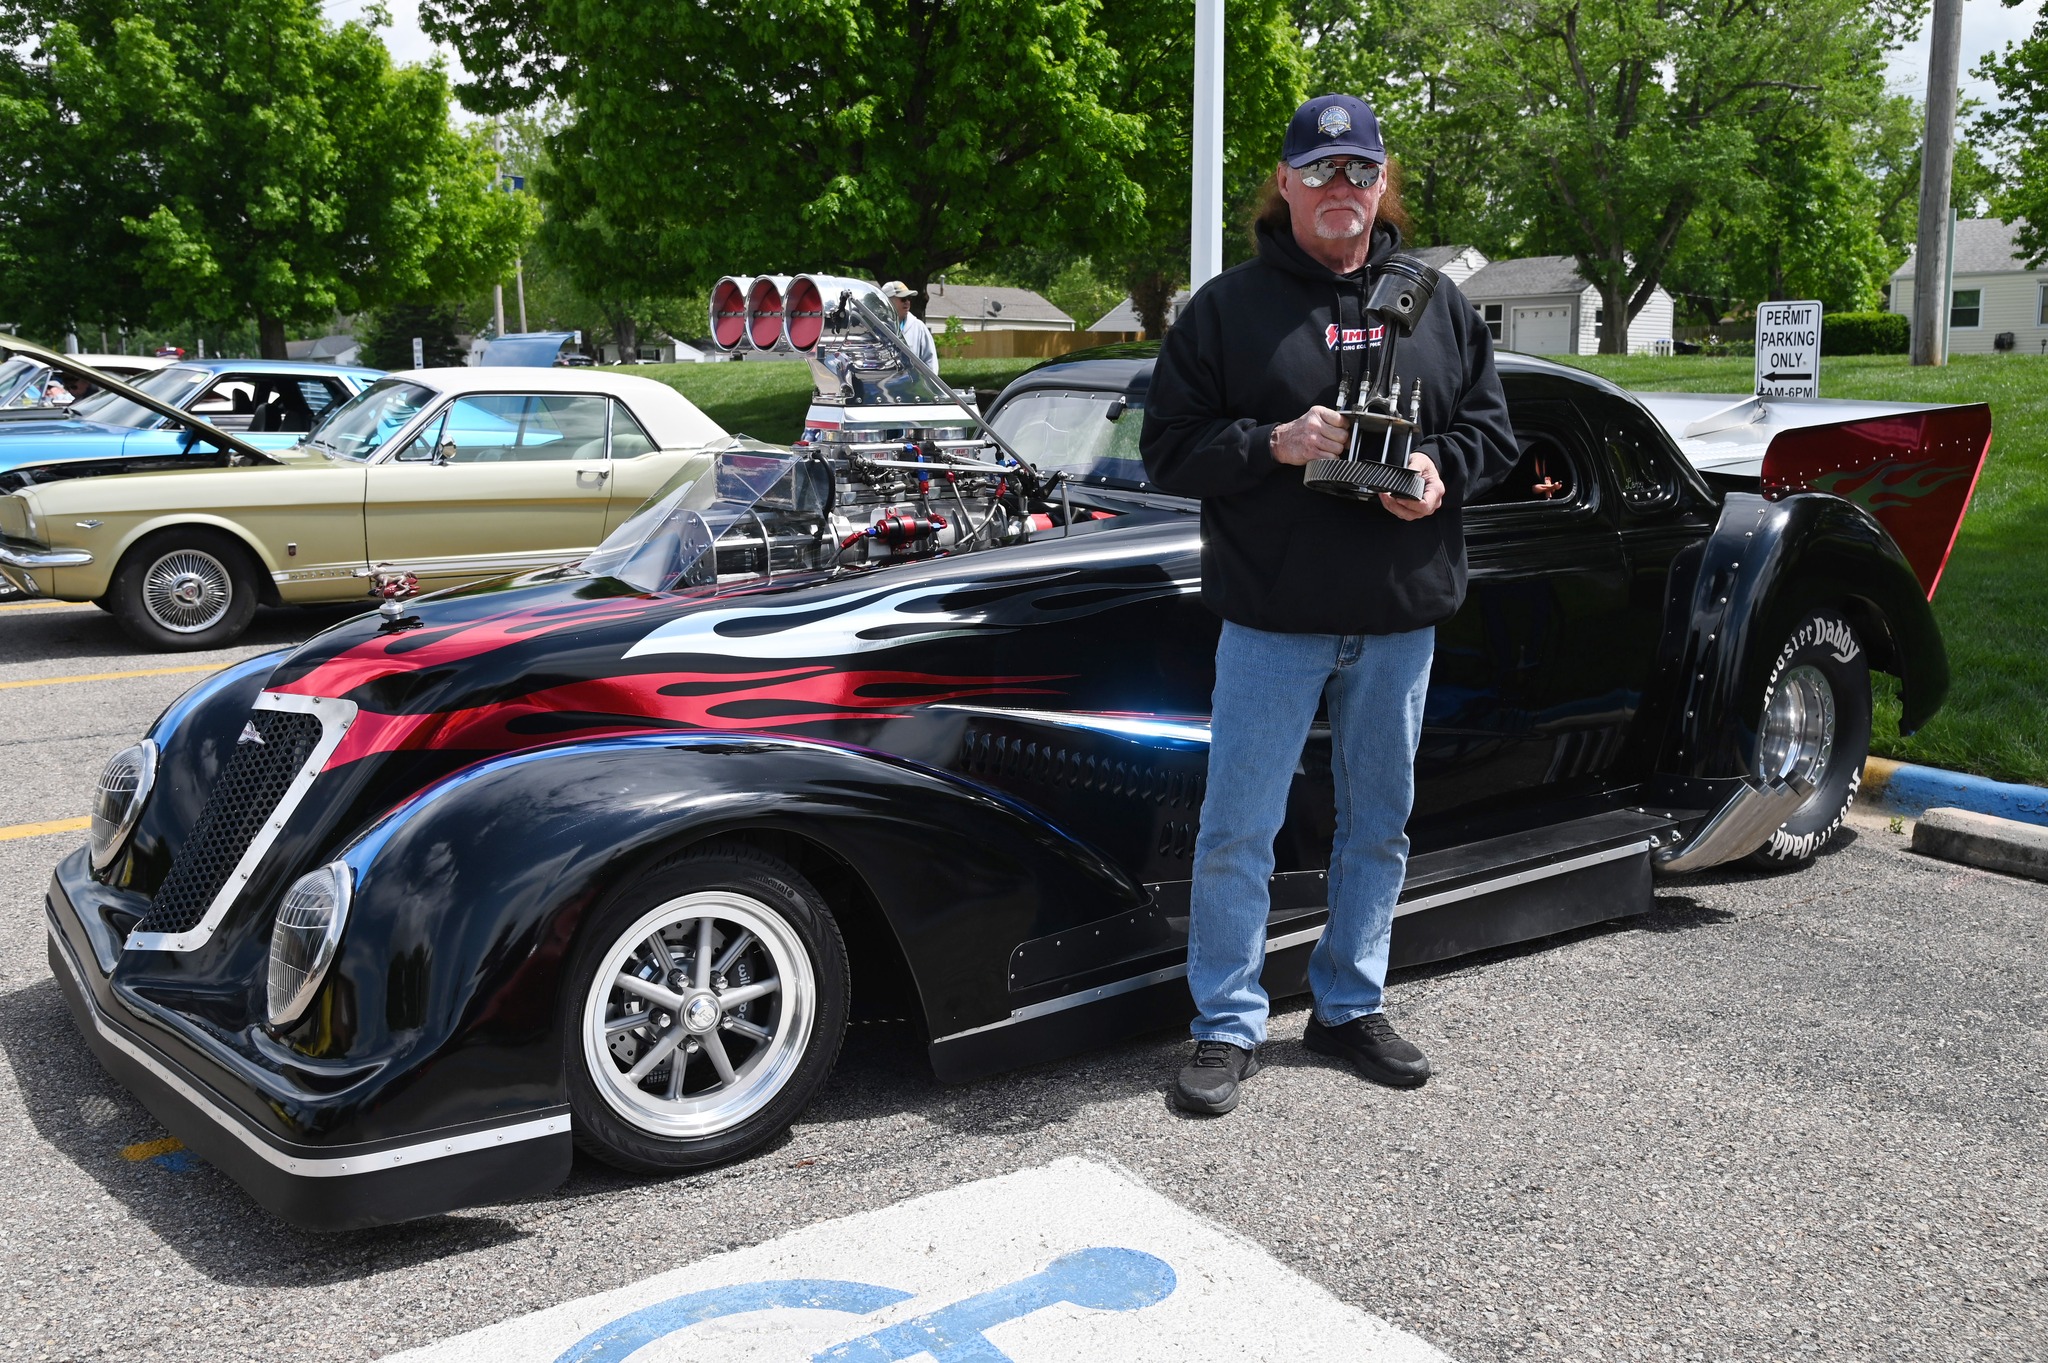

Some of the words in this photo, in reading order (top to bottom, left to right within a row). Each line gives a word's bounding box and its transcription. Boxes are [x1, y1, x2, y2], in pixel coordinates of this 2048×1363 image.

[1766, 309, 1812, 326] PERMIT
[1761, 331, 1815, 347] PARKING
[1770, 352, 1803, 368] ONLY
[1813, 616, 1860, 664] Daddy
